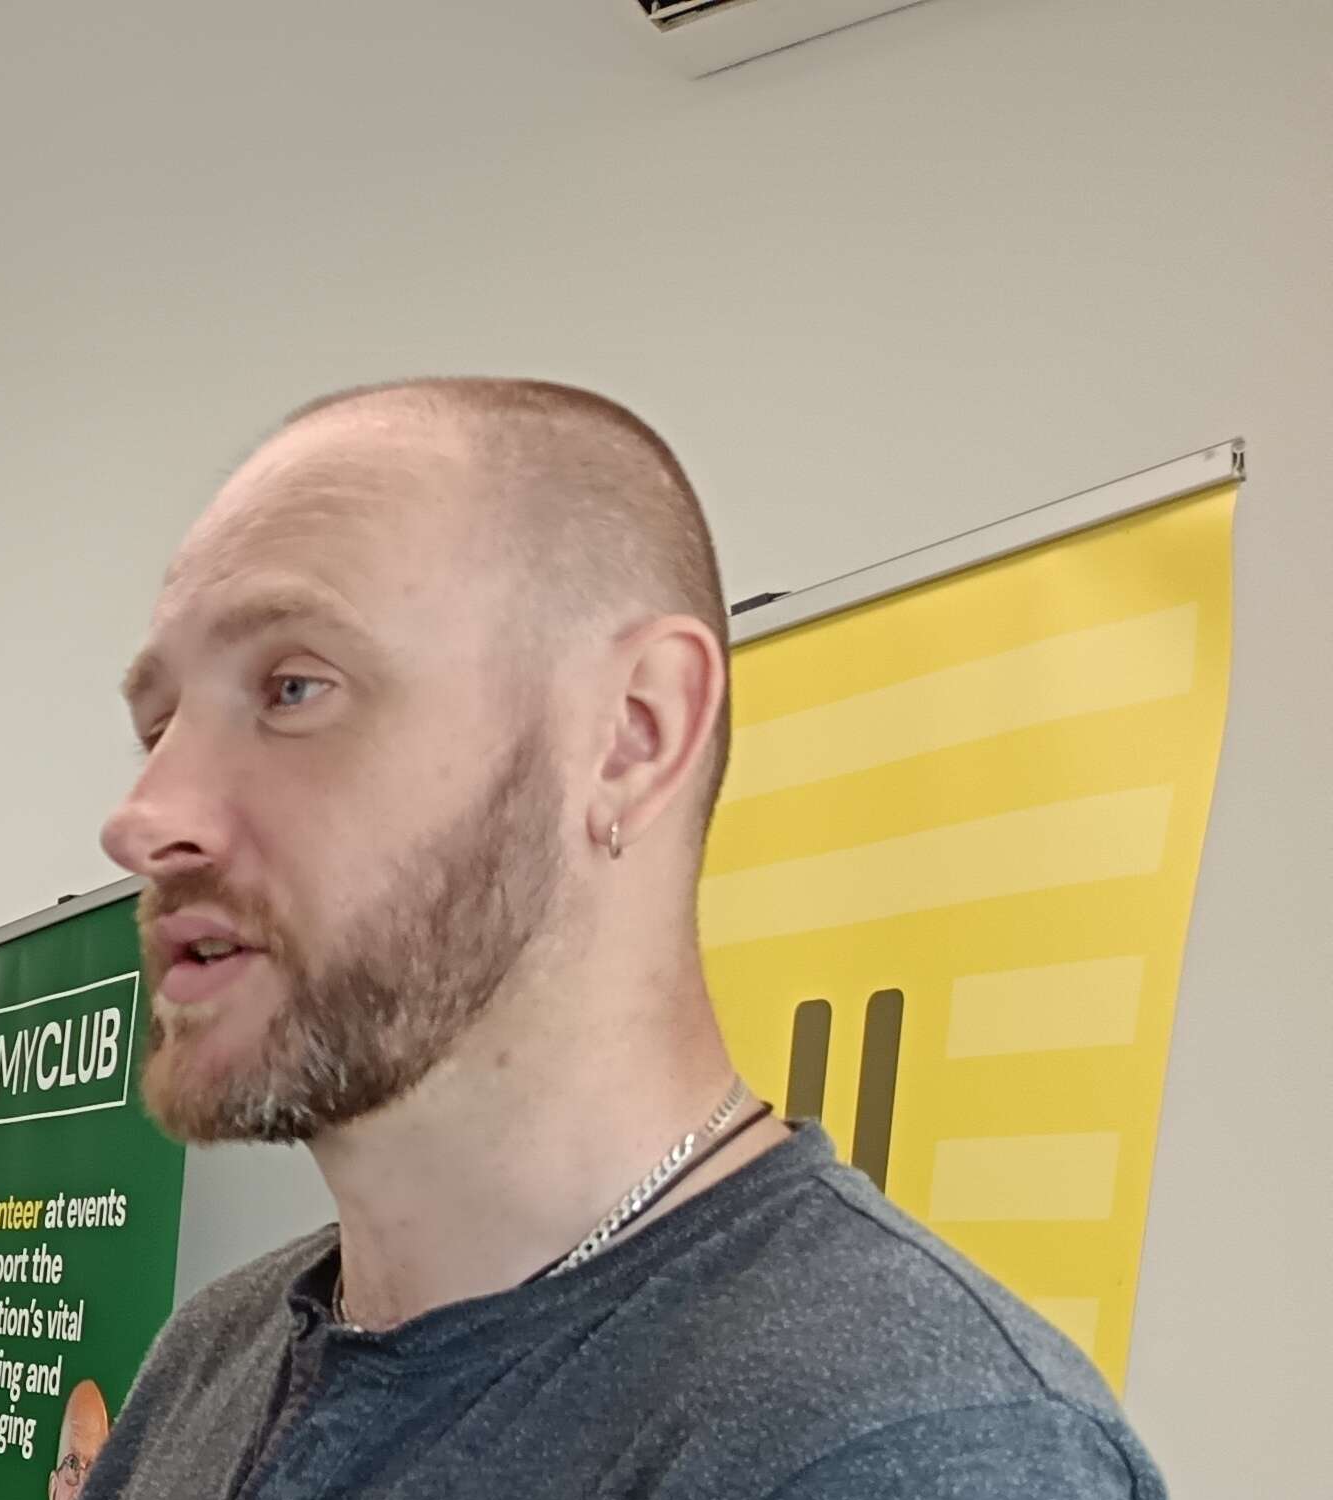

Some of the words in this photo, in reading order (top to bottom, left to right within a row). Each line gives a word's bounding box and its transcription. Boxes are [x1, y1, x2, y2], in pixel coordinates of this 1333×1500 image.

[44, 1192, 66, 1229] at
[66, 1188, 127, 1228] events
[32, 1243, 64, 1285] the
[47, 1299, 84, 1342] vital
[25, 1355, 63, 1397] and
